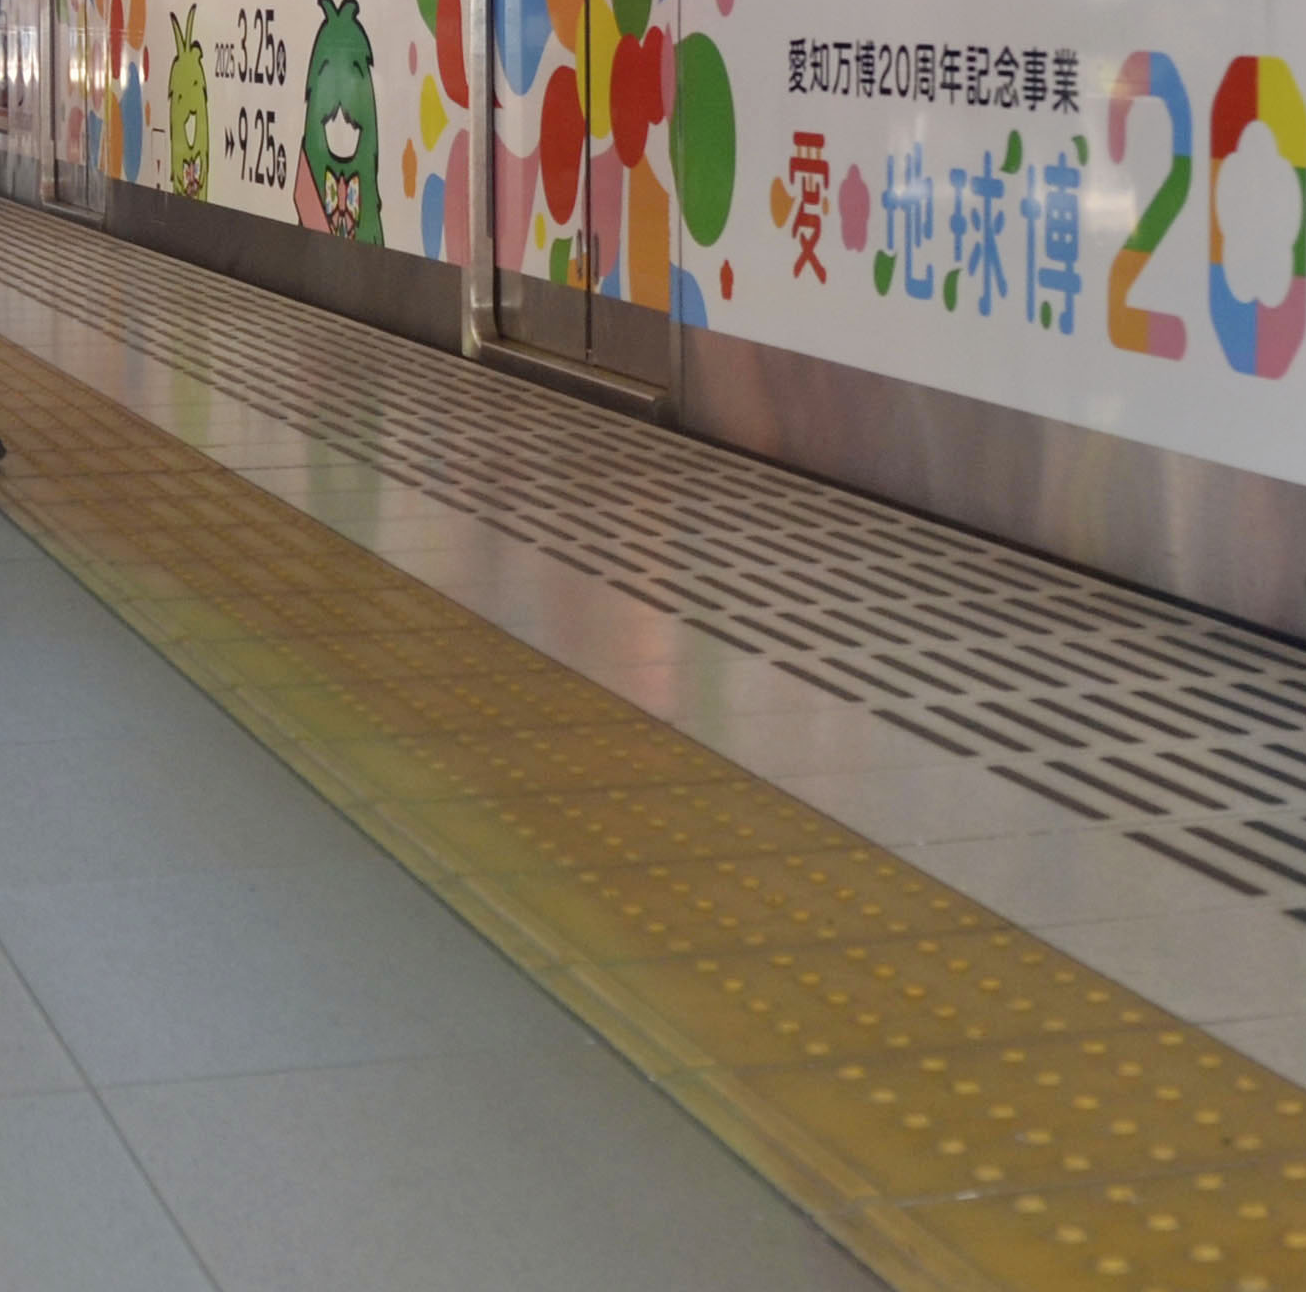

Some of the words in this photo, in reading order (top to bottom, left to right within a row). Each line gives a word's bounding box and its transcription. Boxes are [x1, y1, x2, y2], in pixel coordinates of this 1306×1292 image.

[214, 42, 235, 78] 2025
[787, 37, 1081, 114] 愛知万博20周年記念事業
